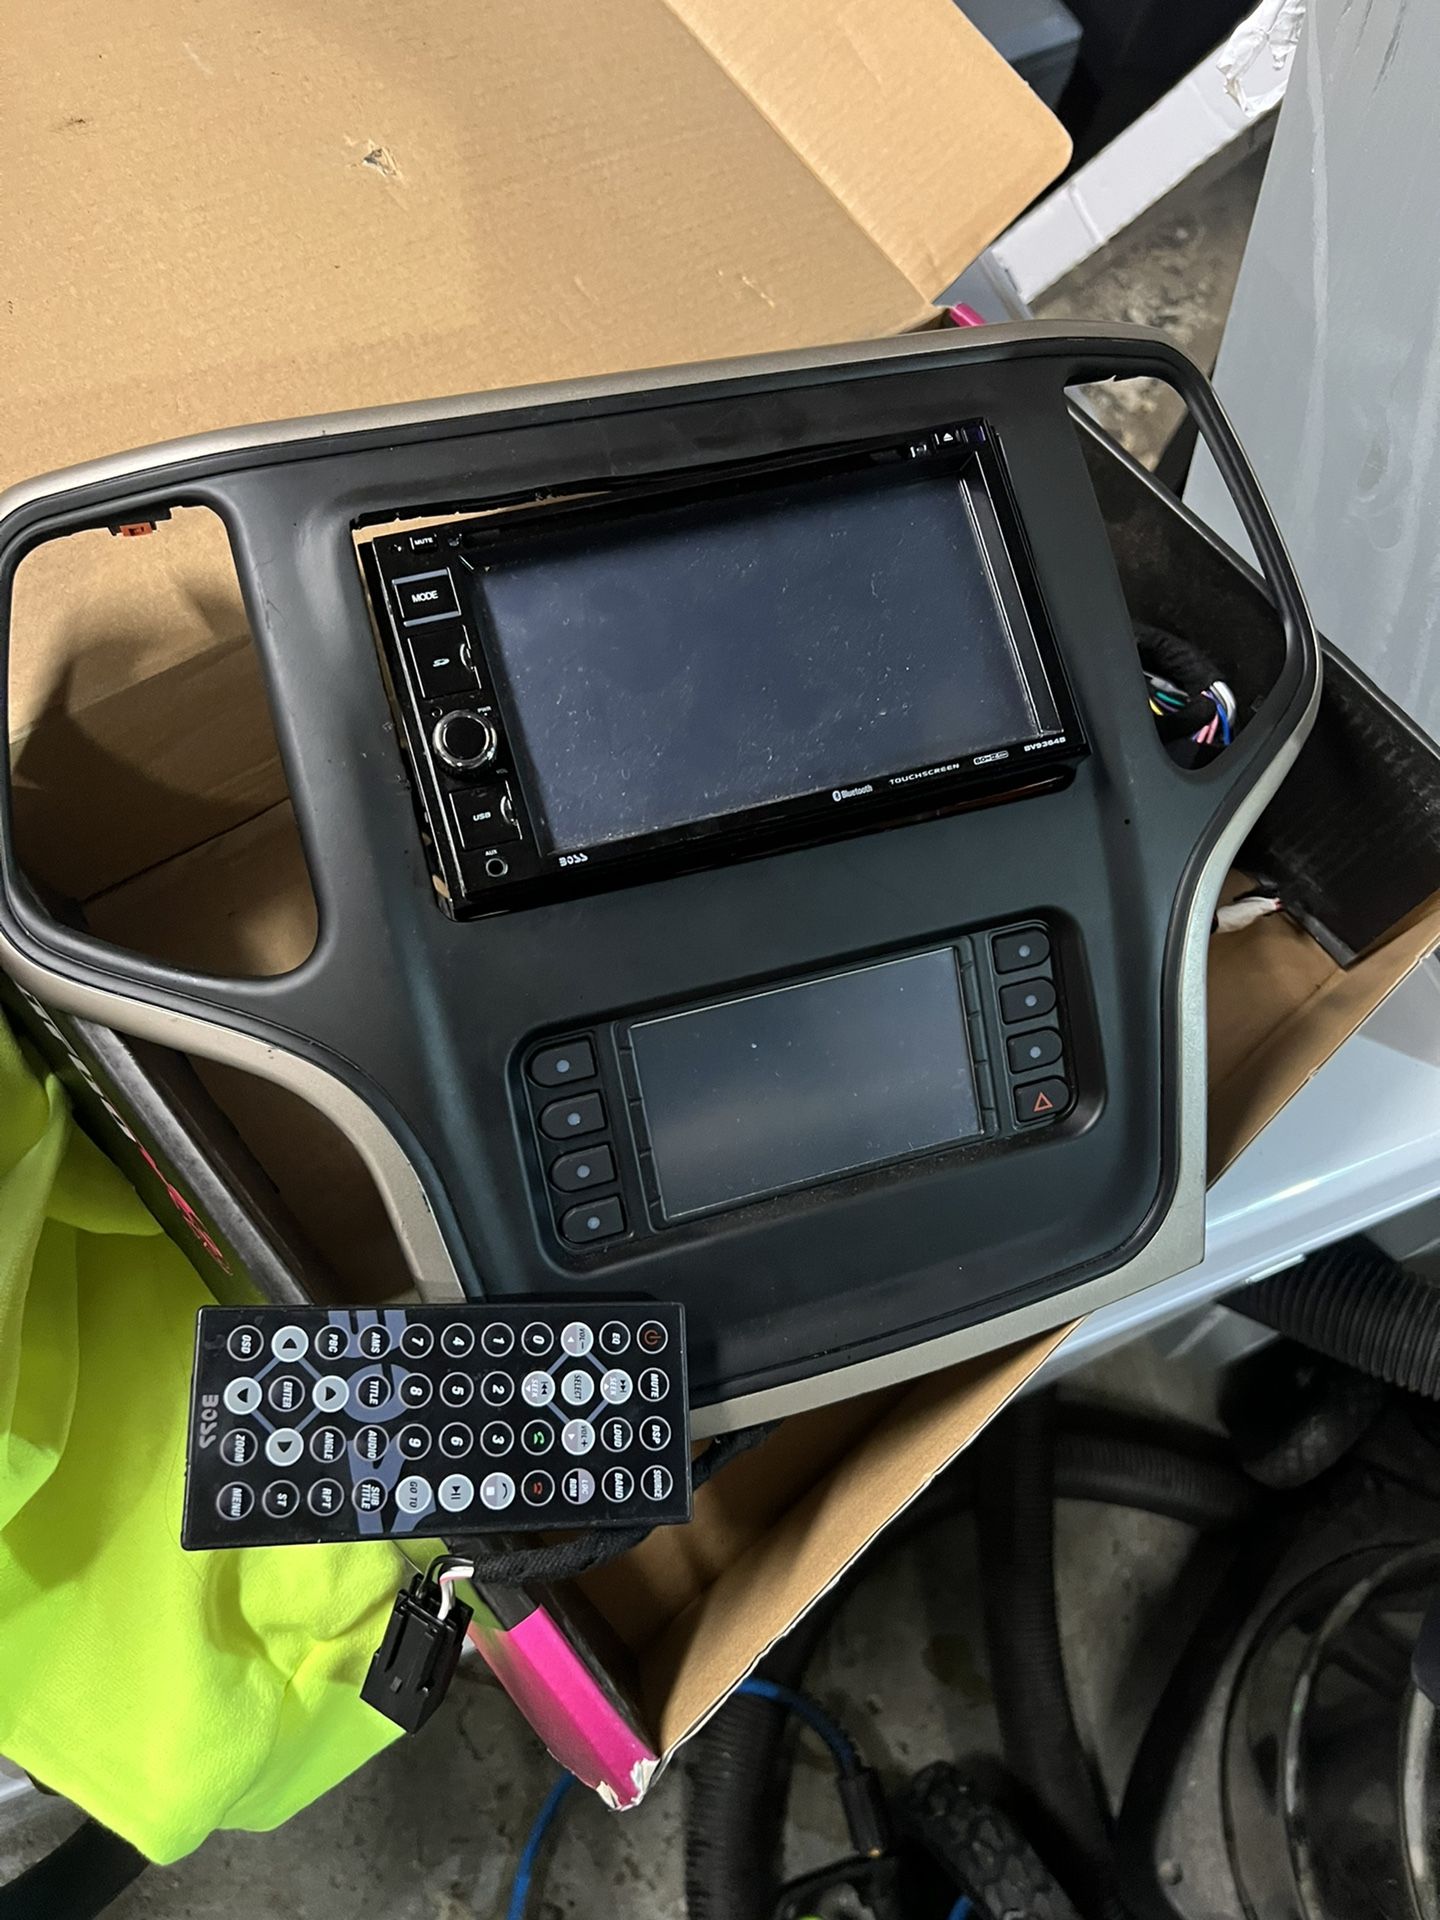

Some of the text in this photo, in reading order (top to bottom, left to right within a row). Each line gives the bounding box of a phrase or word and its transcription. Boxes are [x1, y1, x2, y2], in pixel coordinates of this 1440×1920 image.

[414, 537, 434, 546] MUTE
[411, 590, 439, 603] MODE
[889, 763, 960, 785] TOUCHSCREEN
[841, 784, 873, 799] Bluetooth
[472, 811, 491, 822] USB
[558, 853, 589, 867] BOSS
[241, 1334, 252, 1354] OSD
[327, 1333, 339, 1353] PBC
[370, 1331, 381, 1354] AMS
[411, 1336, 424, 1347] 7
[452, 1336, 465, 1347] 4
[492, 1336, 505, 1345] 1
[532, 1335, 545, 1345] 0
[611, 1332, 621, 1345] EQ
[281, 1381, 293, 1409] ENTER
[368, 1380, 380, 1405] TITLE
[409, 1386, 423, 1397] 8
[451, 1385, 464, 1396] 5
[492, 1385, 505, 1395] 2
[531, 1378, 539, 1398] SEEK
[574, 1374, 582, 1400] SELECT
[609, 1377, 617, 1396] SEEK
[650, 1373, 660, 1398] MUTE
[199, 1394, 219, 1449] BOSS
[408, 1437, 422, 1448] 9
[450, 1436, 464, 1447] 6
[492, 1434, 505, 1445] 3
[613, 1423, 623, 1448] LOUD
[651, 1424, 661, 1444] DSP
[233, 1433, 246, 1463] ZOOM
[323, 1431, 334, 1460] ANGLE
[367, 1430, 379, 1460] AUDIO
[569, 1477, 577, 1498] RDM
[614, 1471, 624, 1500] BAND
[652, 1469, 663, 1499] SOURCE
[230, 1487, 243, 1517] MENU
[276, 1492, 288, 1507] ST
[321, 1487, 333, 1509] RPT
[360, 1483, 371, 1510] TITLE
[370, 1486, 380, 1507] SUB
[409, 1481, 418, 1508] GO TO
